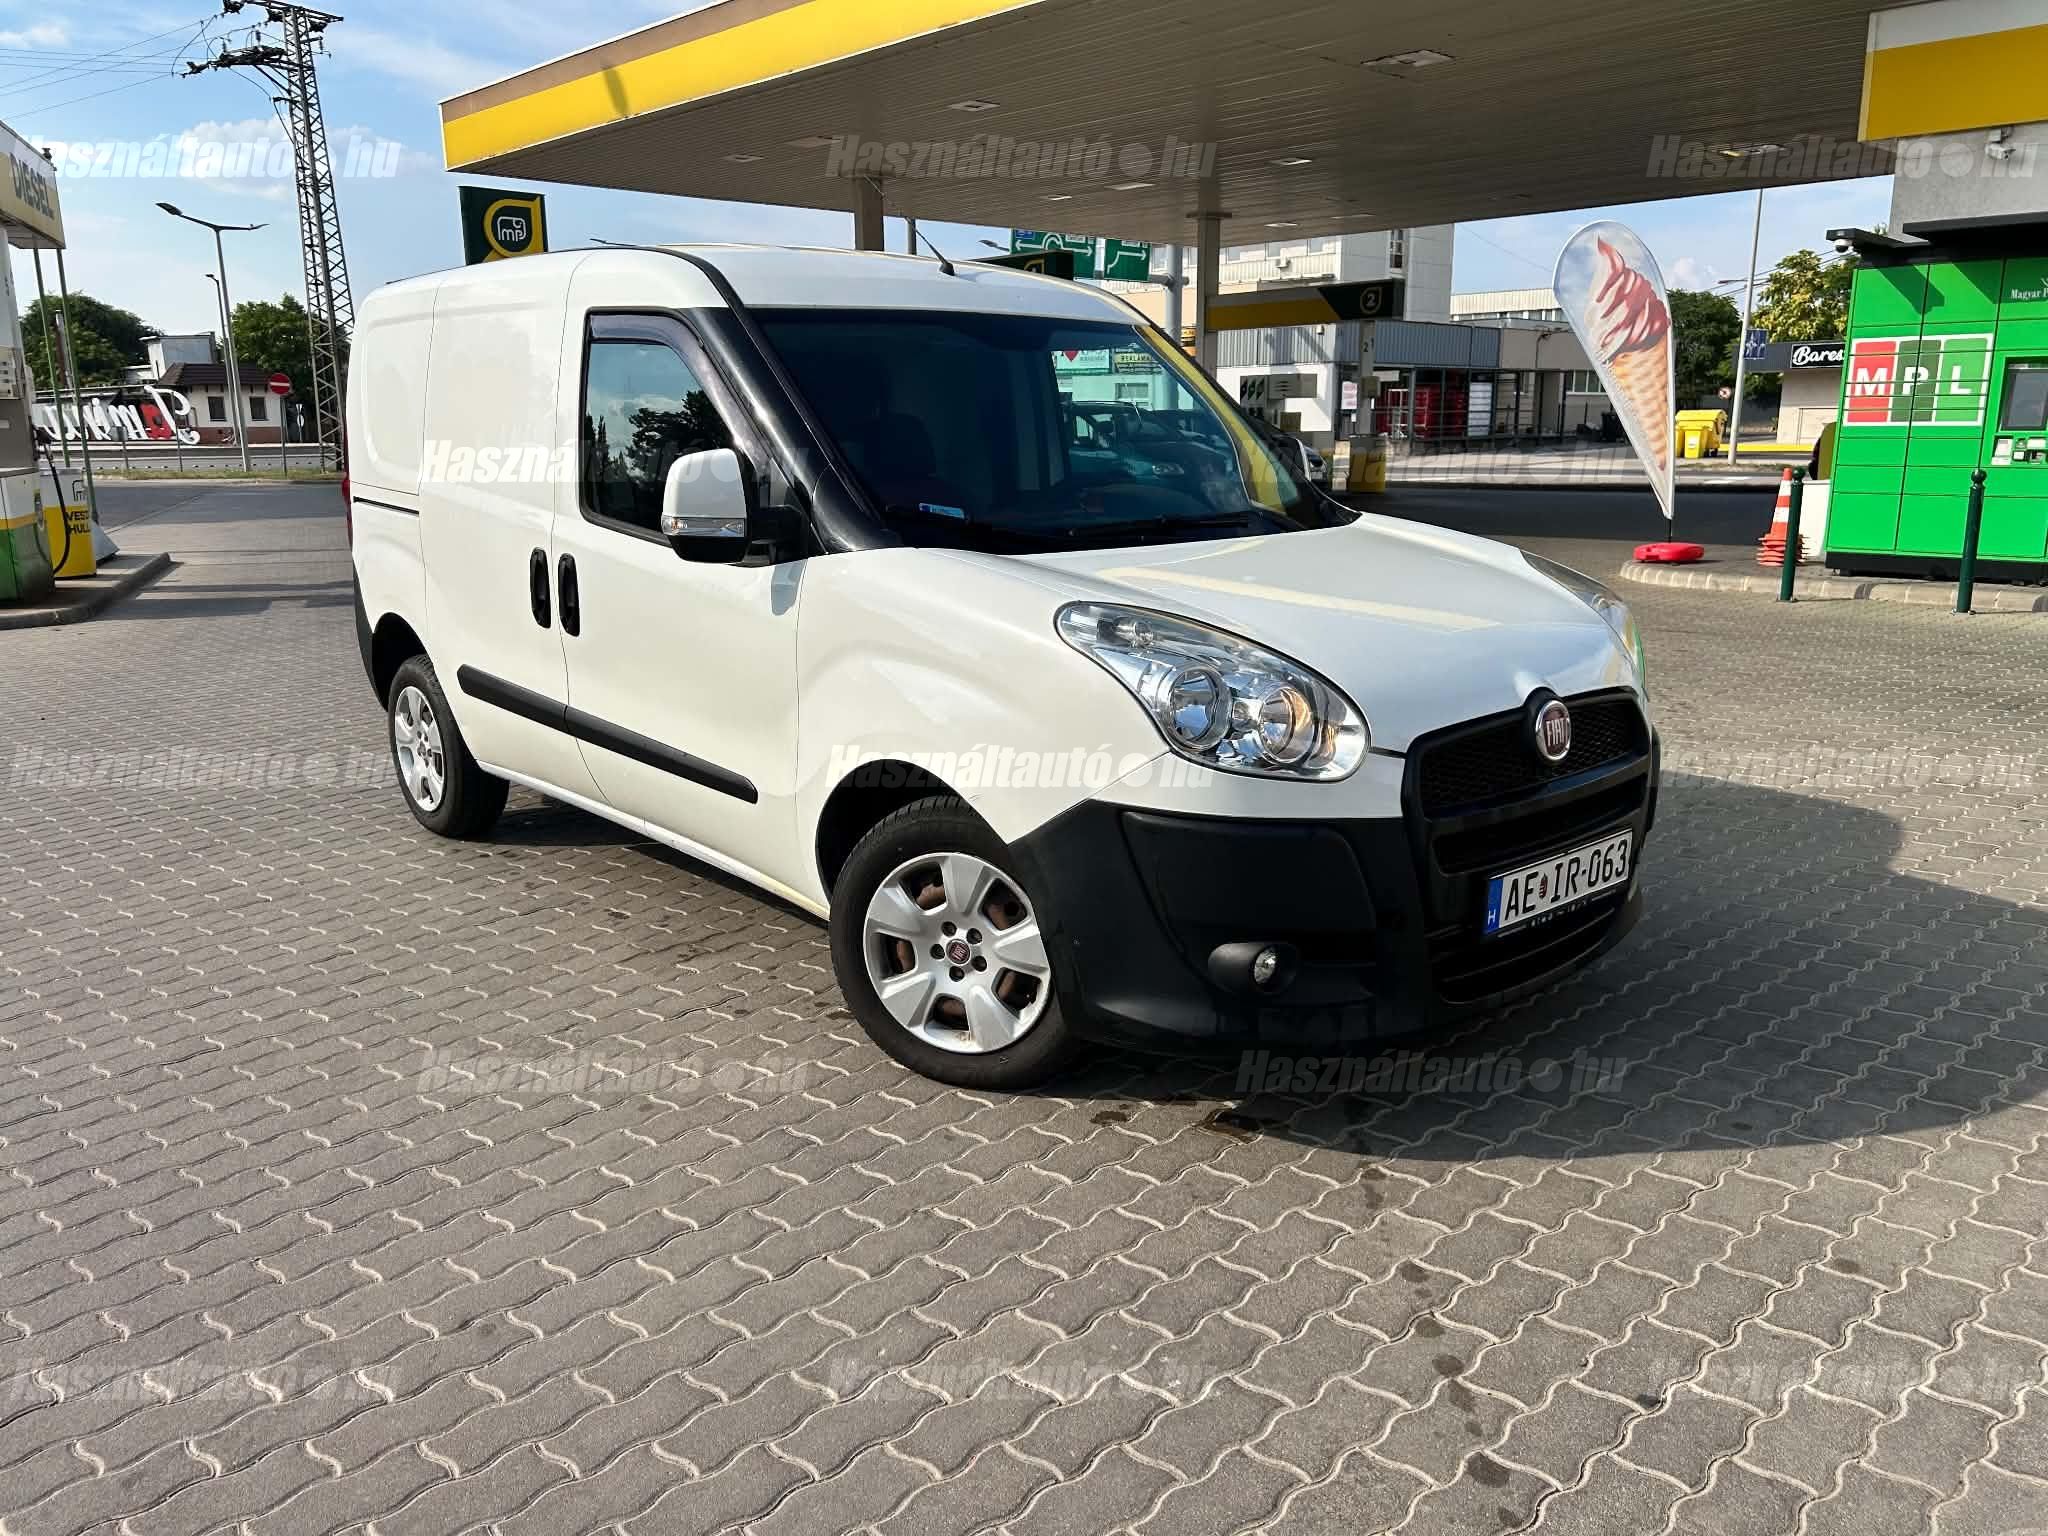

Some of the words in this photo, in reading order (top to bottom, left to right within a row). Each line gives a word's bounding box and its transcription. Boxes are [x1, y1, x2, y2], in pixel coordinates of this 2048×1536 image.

[1366, 292, 1375, 306] 2
[2010, 288, 2041, 301] Magyar
[1854, 366, 1973, 397] MPL
[1546, 718, 1569, 747] FIAT
[1504, 871, 1540, 921] AE
[1550, 838, 1628, 904] IR-063
[1487, 908, 1497, 925] H
